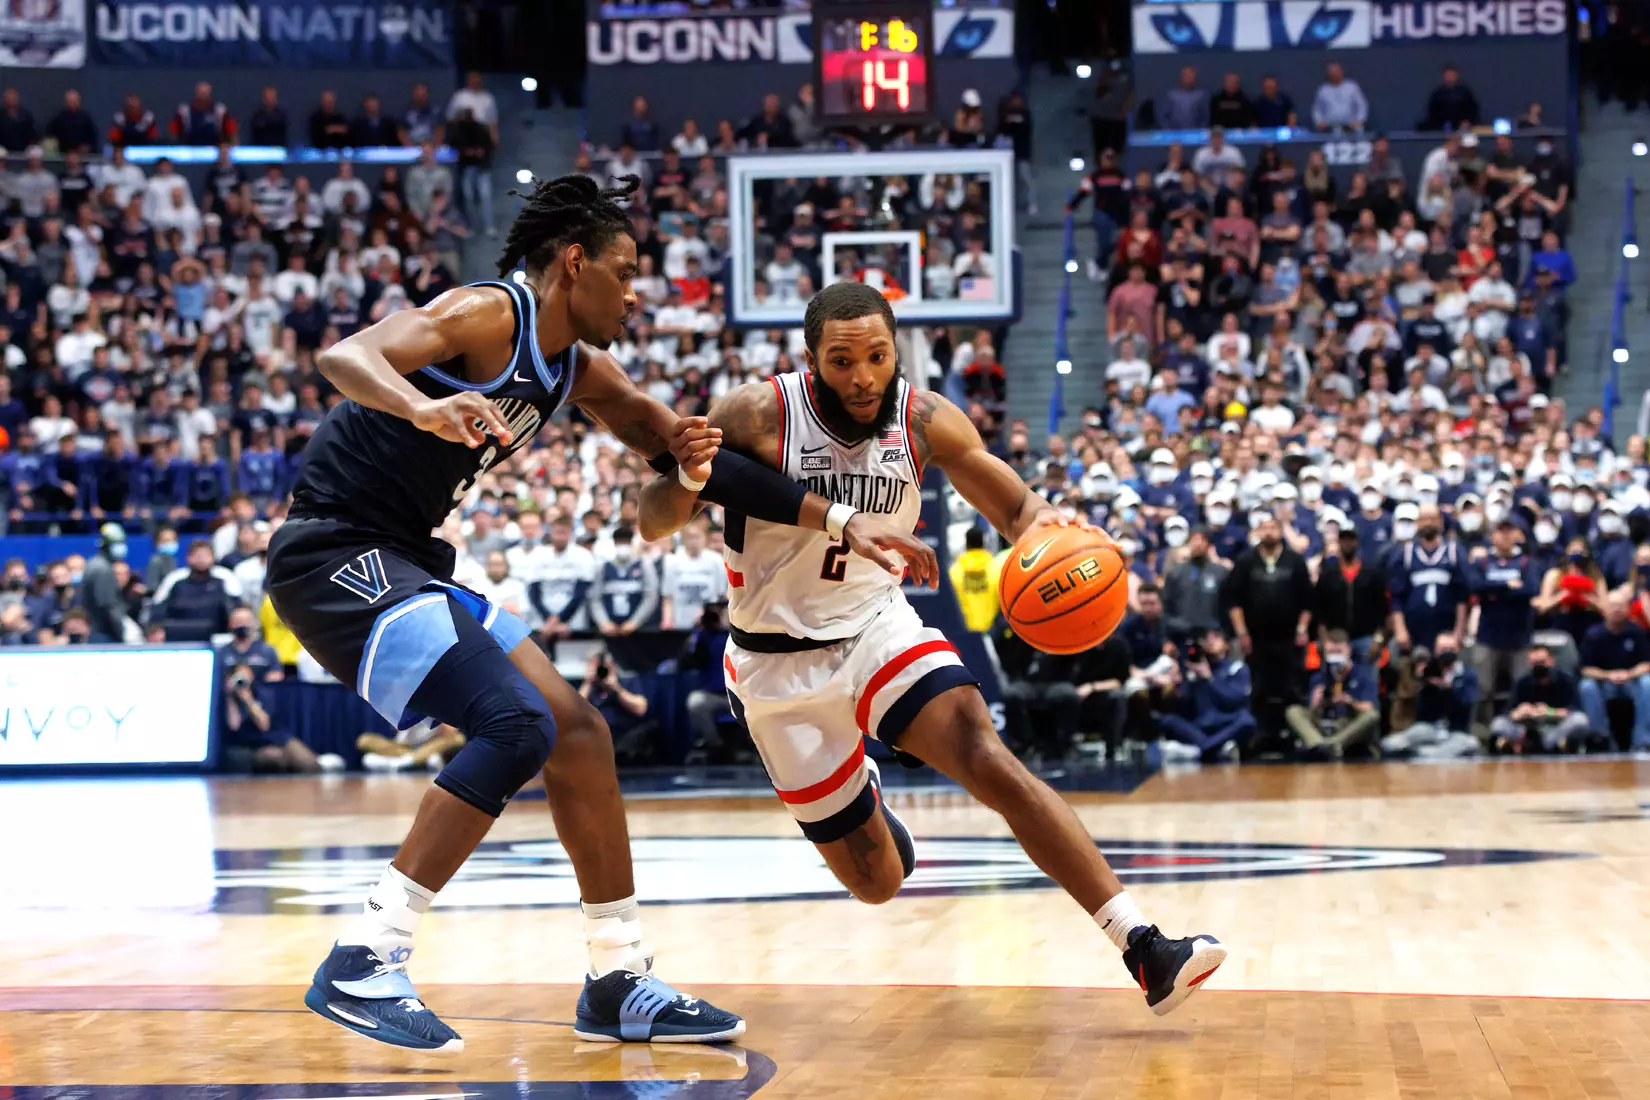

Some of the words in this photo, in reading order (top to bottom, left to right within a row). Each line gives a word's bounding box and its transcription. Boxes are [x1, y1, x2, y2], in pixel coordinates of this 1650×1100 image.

[97, 5, 261, 41] UCONN
[1373, 0, 1566, 38] HUSKIES
[587, 17, 775, 64] UCONN
[862, 59, 909, 111] 14
[1323, 141, 1372, 165] 122
[881, 453, 906, 462] EAST
[820, 532, 851, 582] 2
[1037, 557, 1102, 604] ELITE
